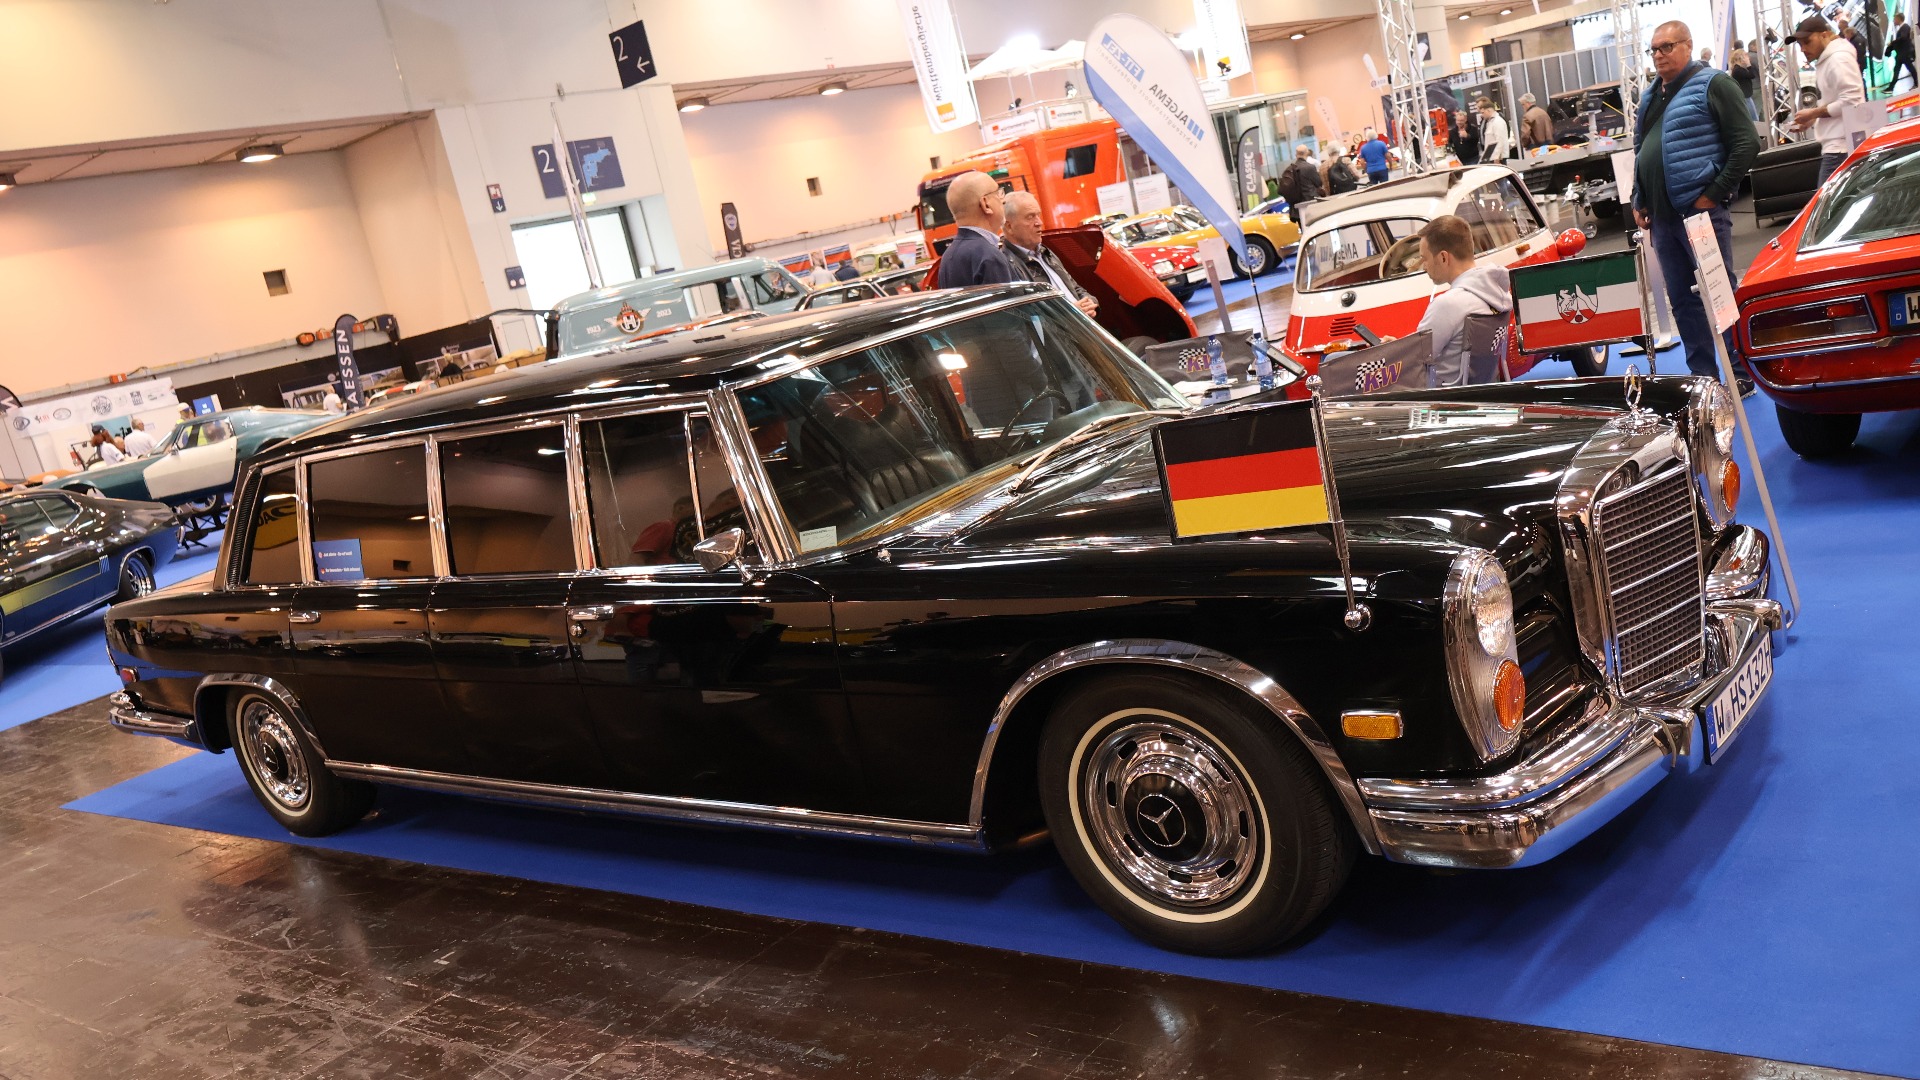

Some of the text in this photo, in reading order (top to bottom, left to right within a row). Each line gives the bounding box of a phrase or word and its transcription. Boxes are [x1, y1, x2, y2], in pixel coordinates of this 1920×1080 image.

[613, 36, 628, 62] 2
[538, 149, 554, 173] 2
[1244, 151, 1256, 193] CLASSIC
[1327, 242, 1359, 262] AEMA
[656, 308, 672, 318] 2023
[1895, 313, 1902, 321] D
[586, 326, 601, 335] 1923
[1362, 361, 1402, 393] KW
[1714, 698, 1725, 739] W
